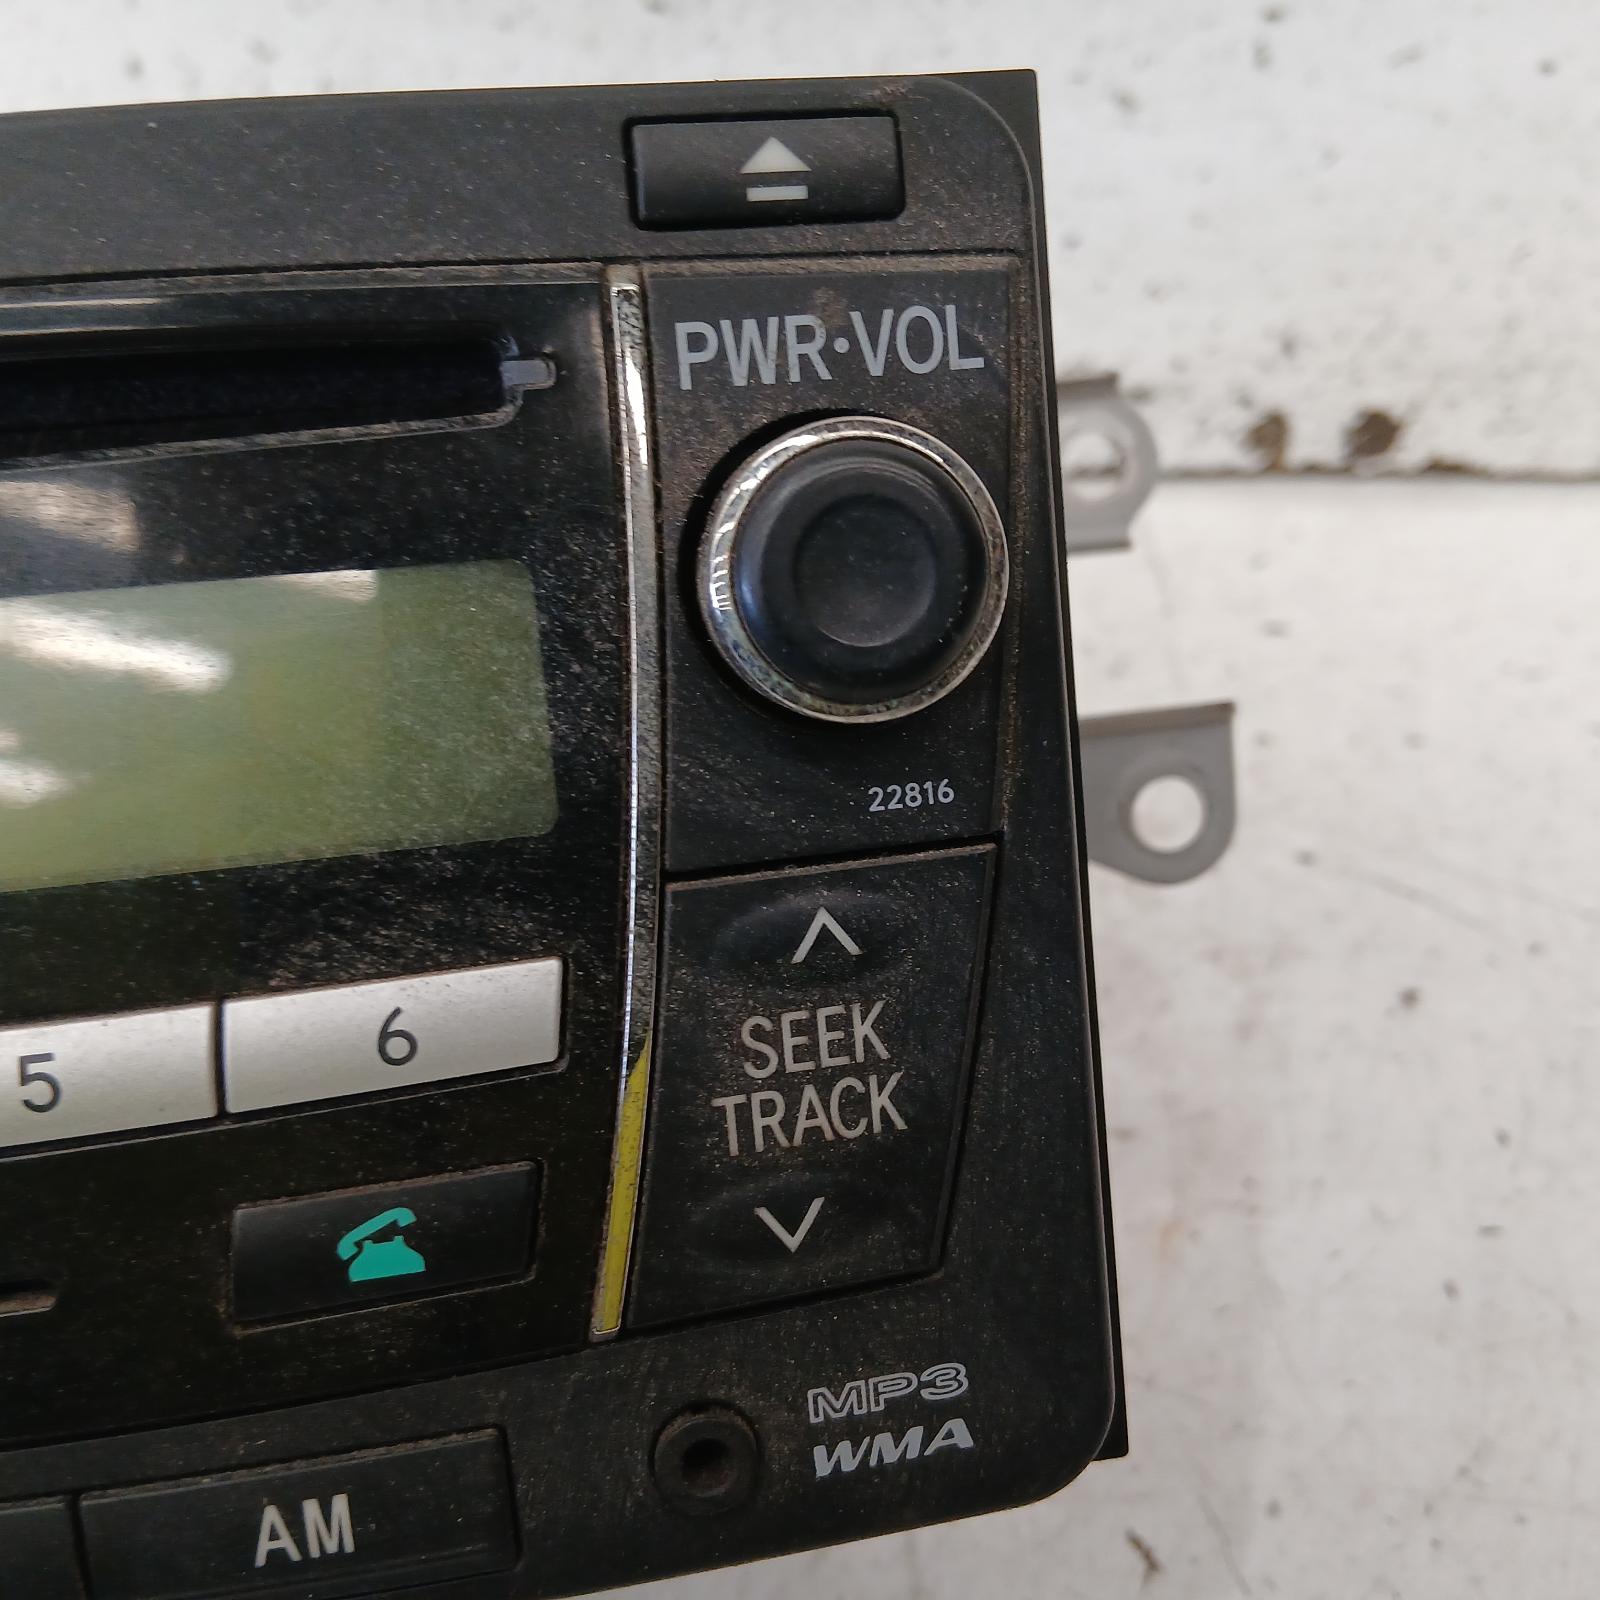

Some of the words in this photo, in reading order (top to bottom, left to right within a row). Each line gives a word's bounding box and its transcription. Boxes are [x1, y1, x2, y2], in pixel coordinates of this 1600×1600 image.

[868, 779, 955, 812] 22816
[377, 1007, 418, 1066] 6
[740, 1001, 891, 1079] SEEK
[18, 1052, 61, 1112] 5
[711, 1071, 908, 1156] TRACK
[807, 1362, 969, 1423] MP3
[813, 1417, 975, 1477] WMA
[254, 1493, 356, 1568] AM
